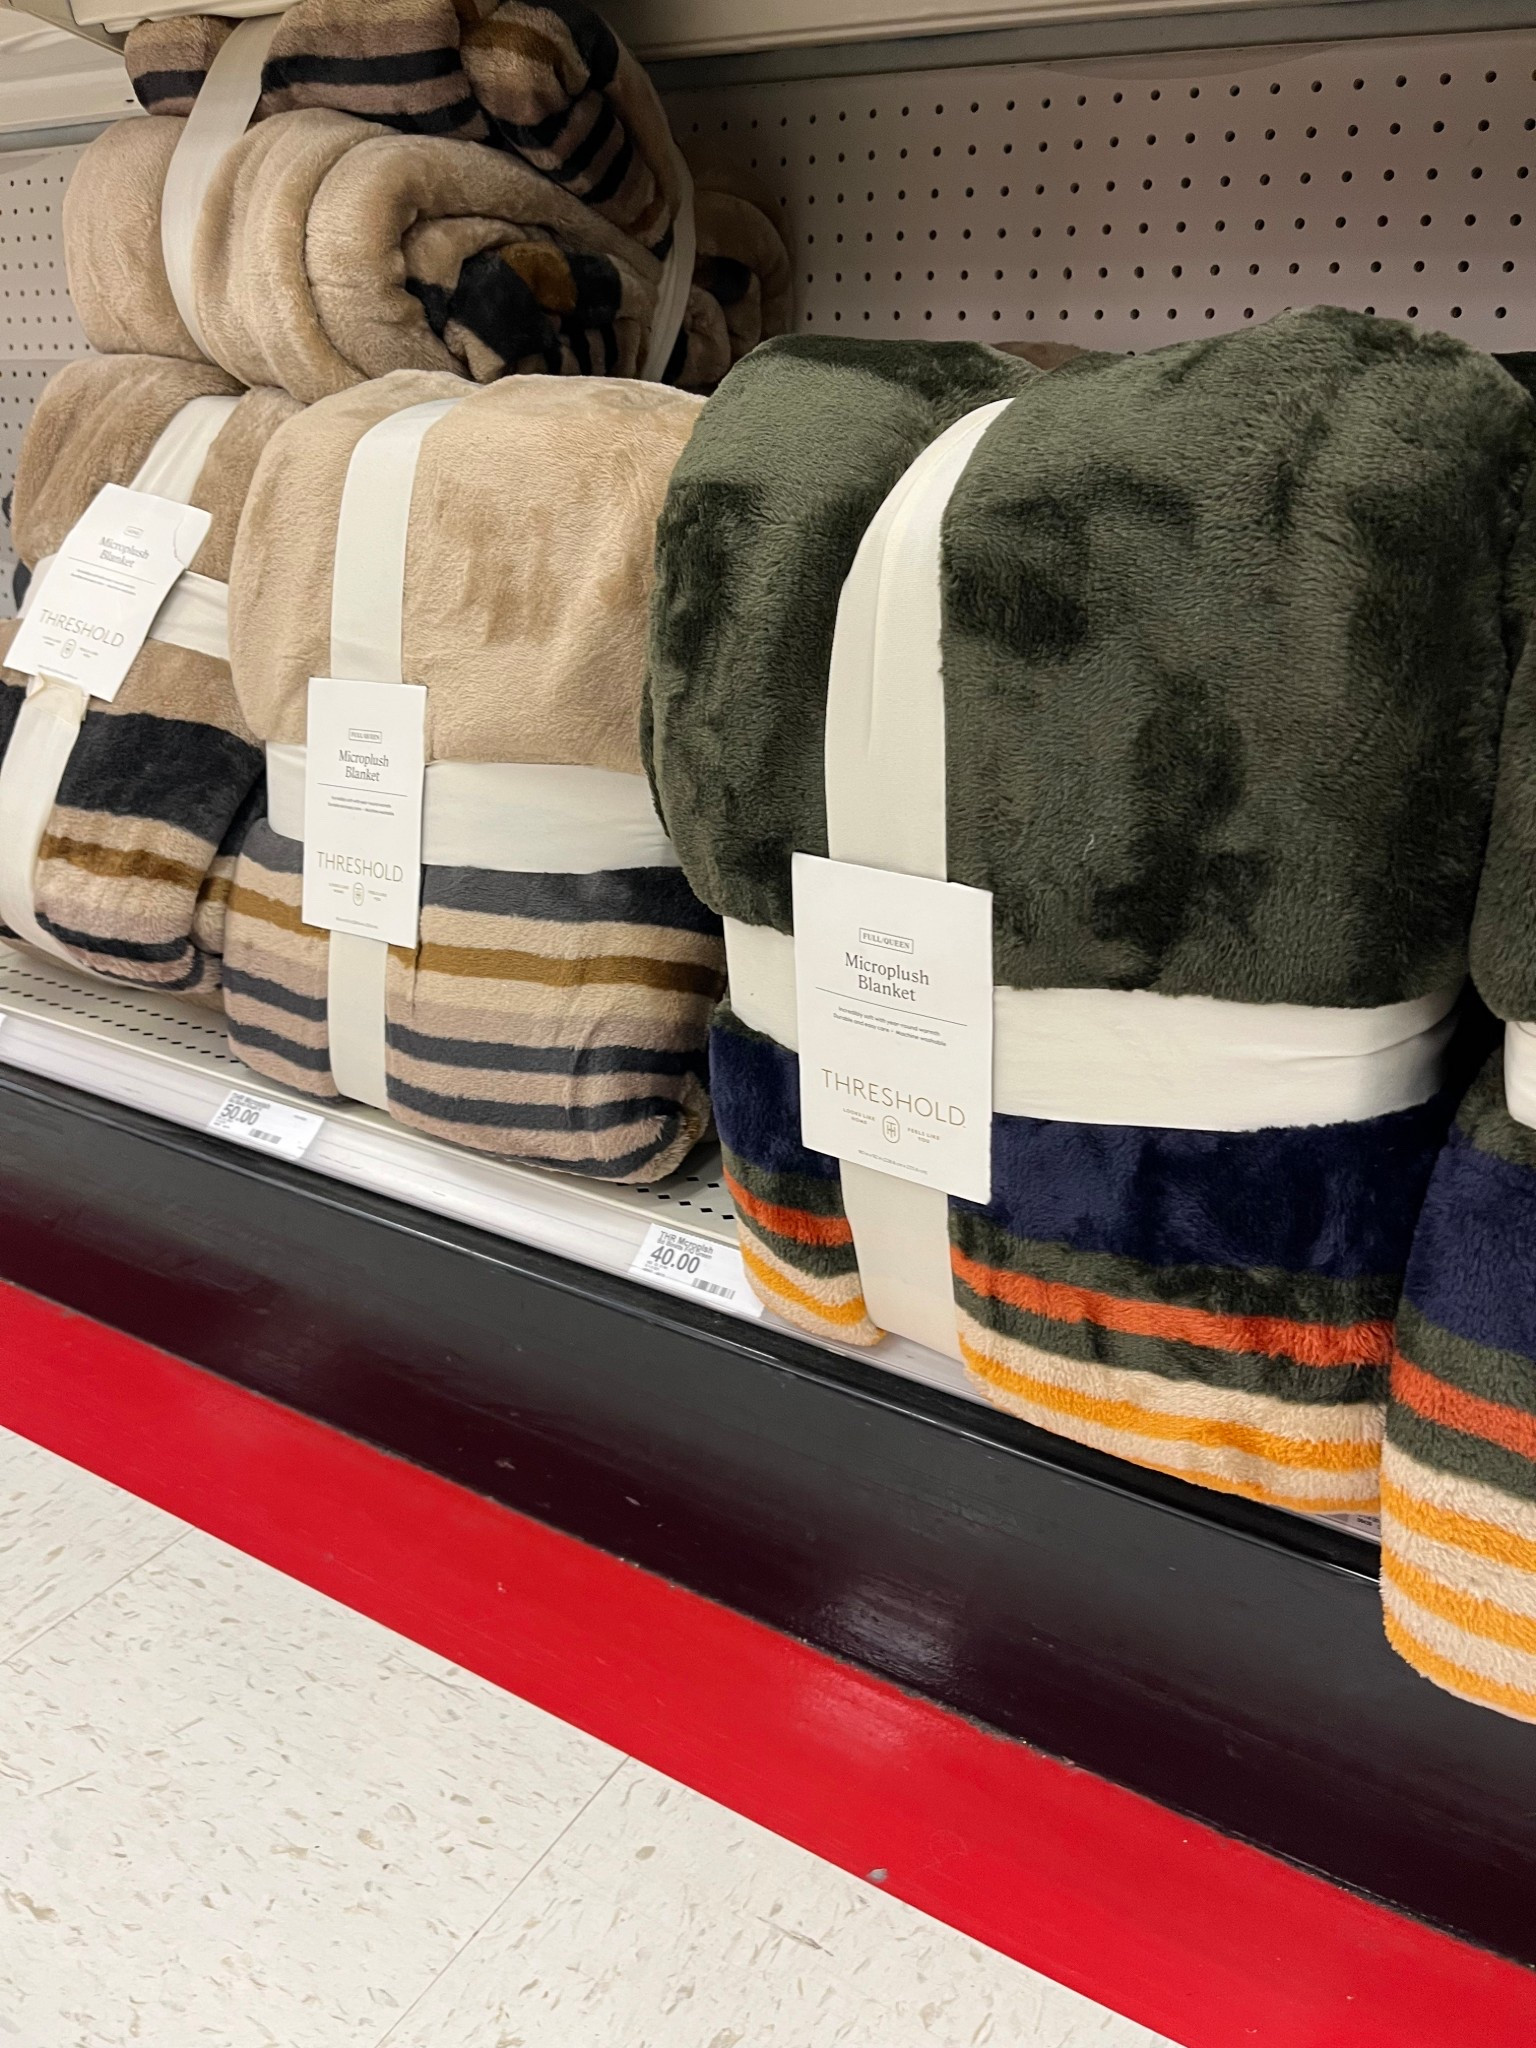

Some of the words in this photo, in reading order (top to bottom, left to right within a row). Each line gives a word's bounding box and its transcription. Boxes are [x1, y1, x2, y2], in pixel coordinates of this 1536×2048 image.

[99, 536, 149, 560] Microplush
[99, 550, 135, 568] Blanket
[40, 608, 124, 647] THRESHOLD
[338, 749, 389, 767] Microplush
[345, 765, 381, 782] Blanket
[317, 851, 404, 882] THRESHOLD
[862, 932, 910, 949] FULL/QUEEN
[845, 952, 930, 986] Microplush
[858, 974, 916, 1002] Blanket
[821, 1068, 966, 1126] THRESHOLD
[220, 1104, 260, 1126] 50.00
[650, 1246, 700, 1274] 40.00
